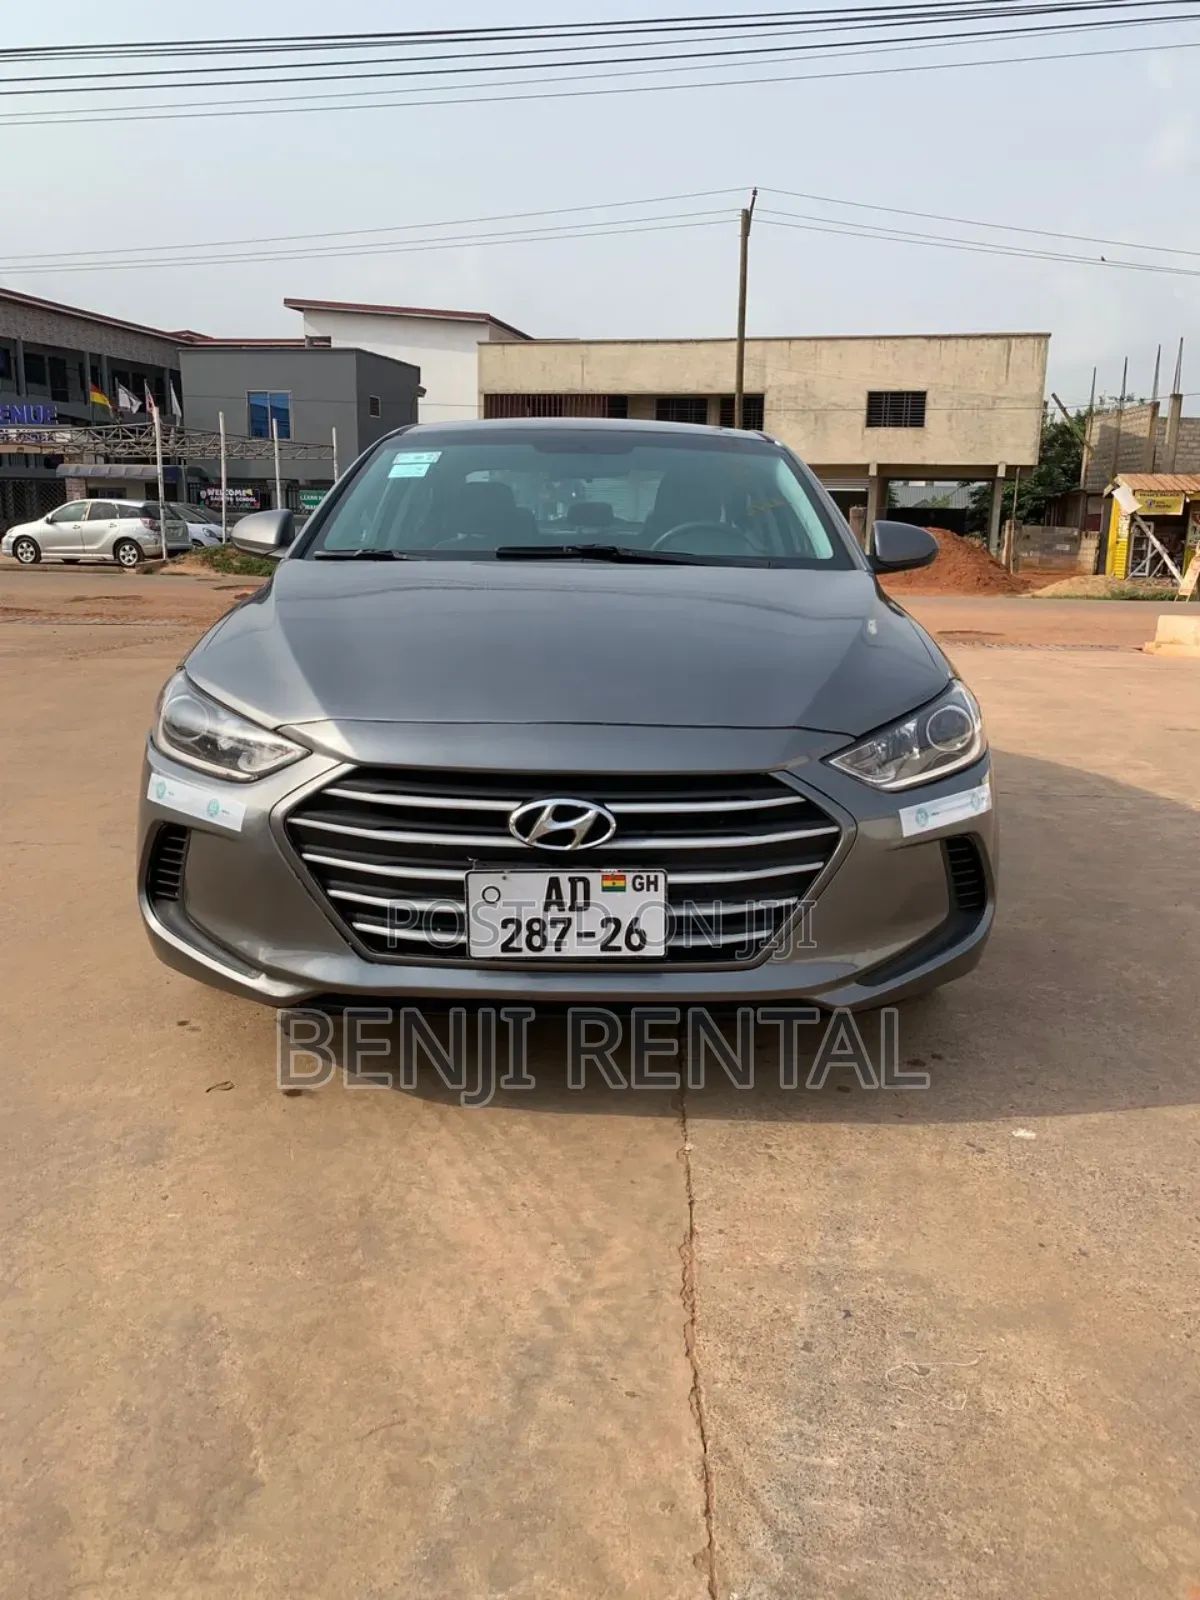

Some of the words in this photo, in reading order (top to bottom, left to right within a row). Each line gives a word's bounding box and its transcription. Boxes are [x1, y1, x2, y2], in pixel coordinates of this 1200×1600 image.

[543, 876, 591, 912] AD
[632, 874, 659, 893] GH
[500, 917, 647, 953] 287-26
